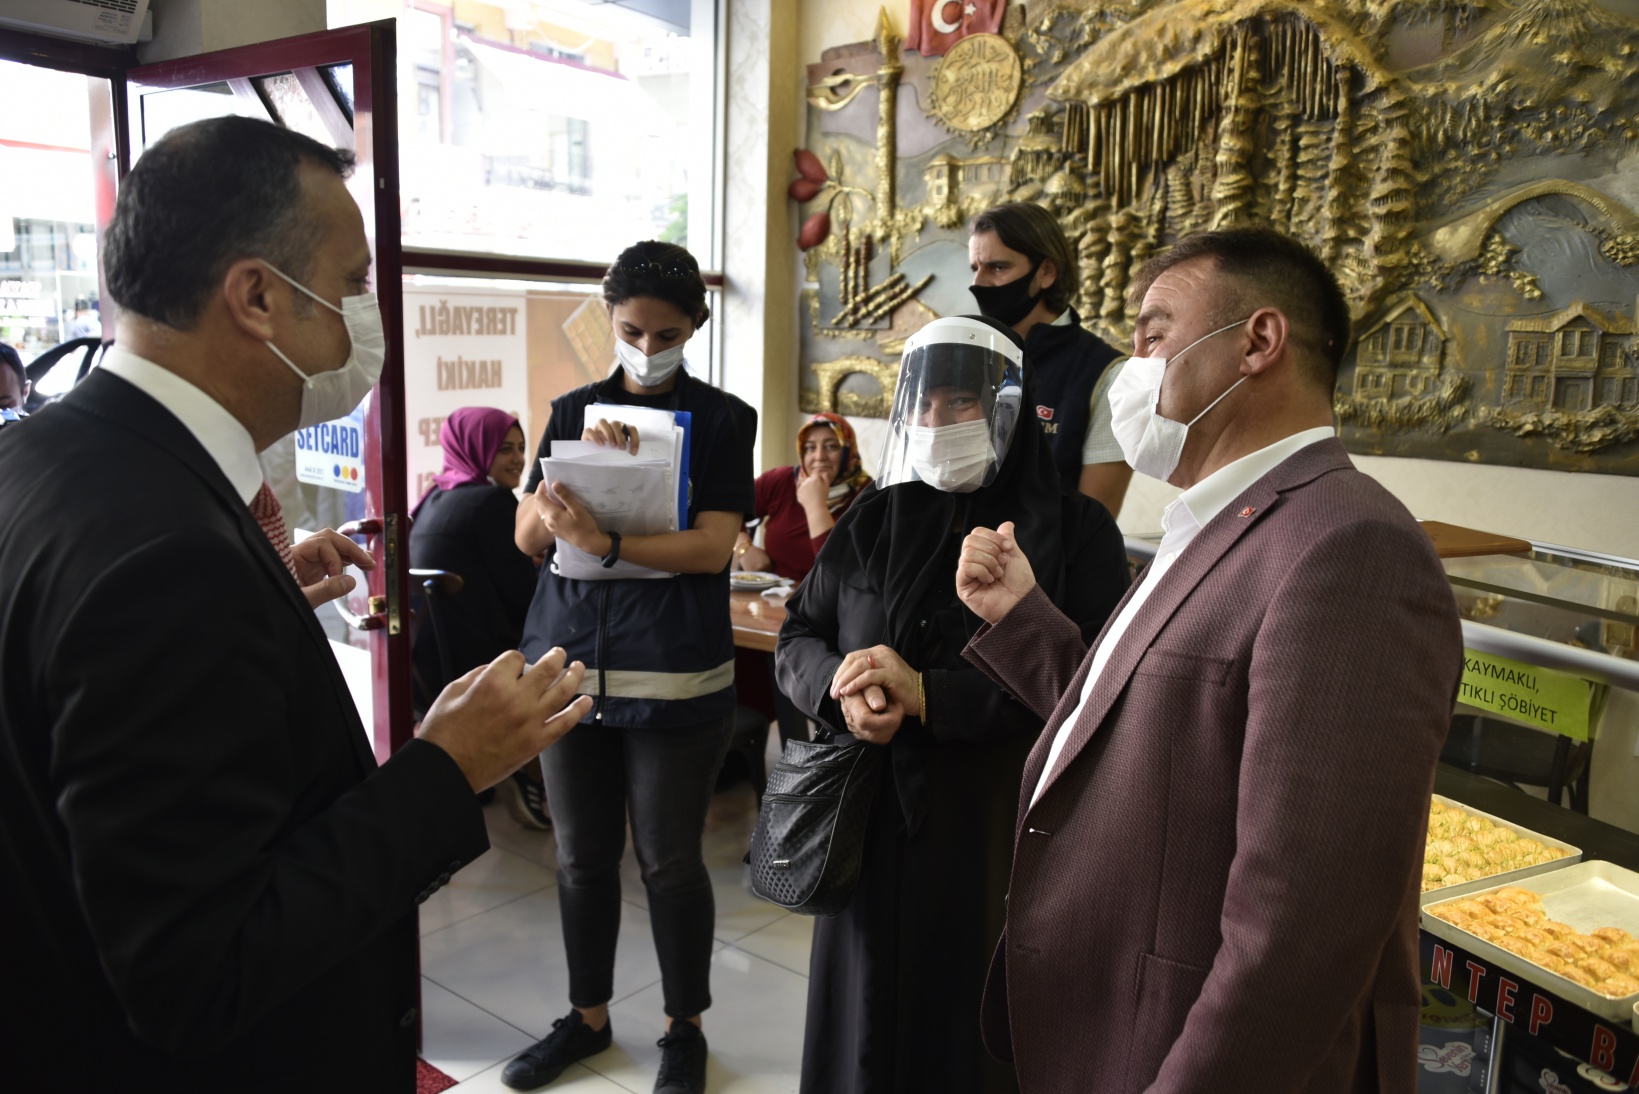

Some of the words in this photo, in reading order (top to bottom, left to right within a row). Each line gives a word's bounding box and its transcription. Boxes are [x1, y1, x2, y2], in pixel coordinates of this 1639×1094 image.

[297, 423, 359, 458] SETCARD
[1040, 422, 1059, 434] M
[1464, 657, 1539, 694] KAYMAKLI,
[1499, 693, 1557, 724] ŞÖBİYET
[1431, 944, 1553, 1036] NTEP
